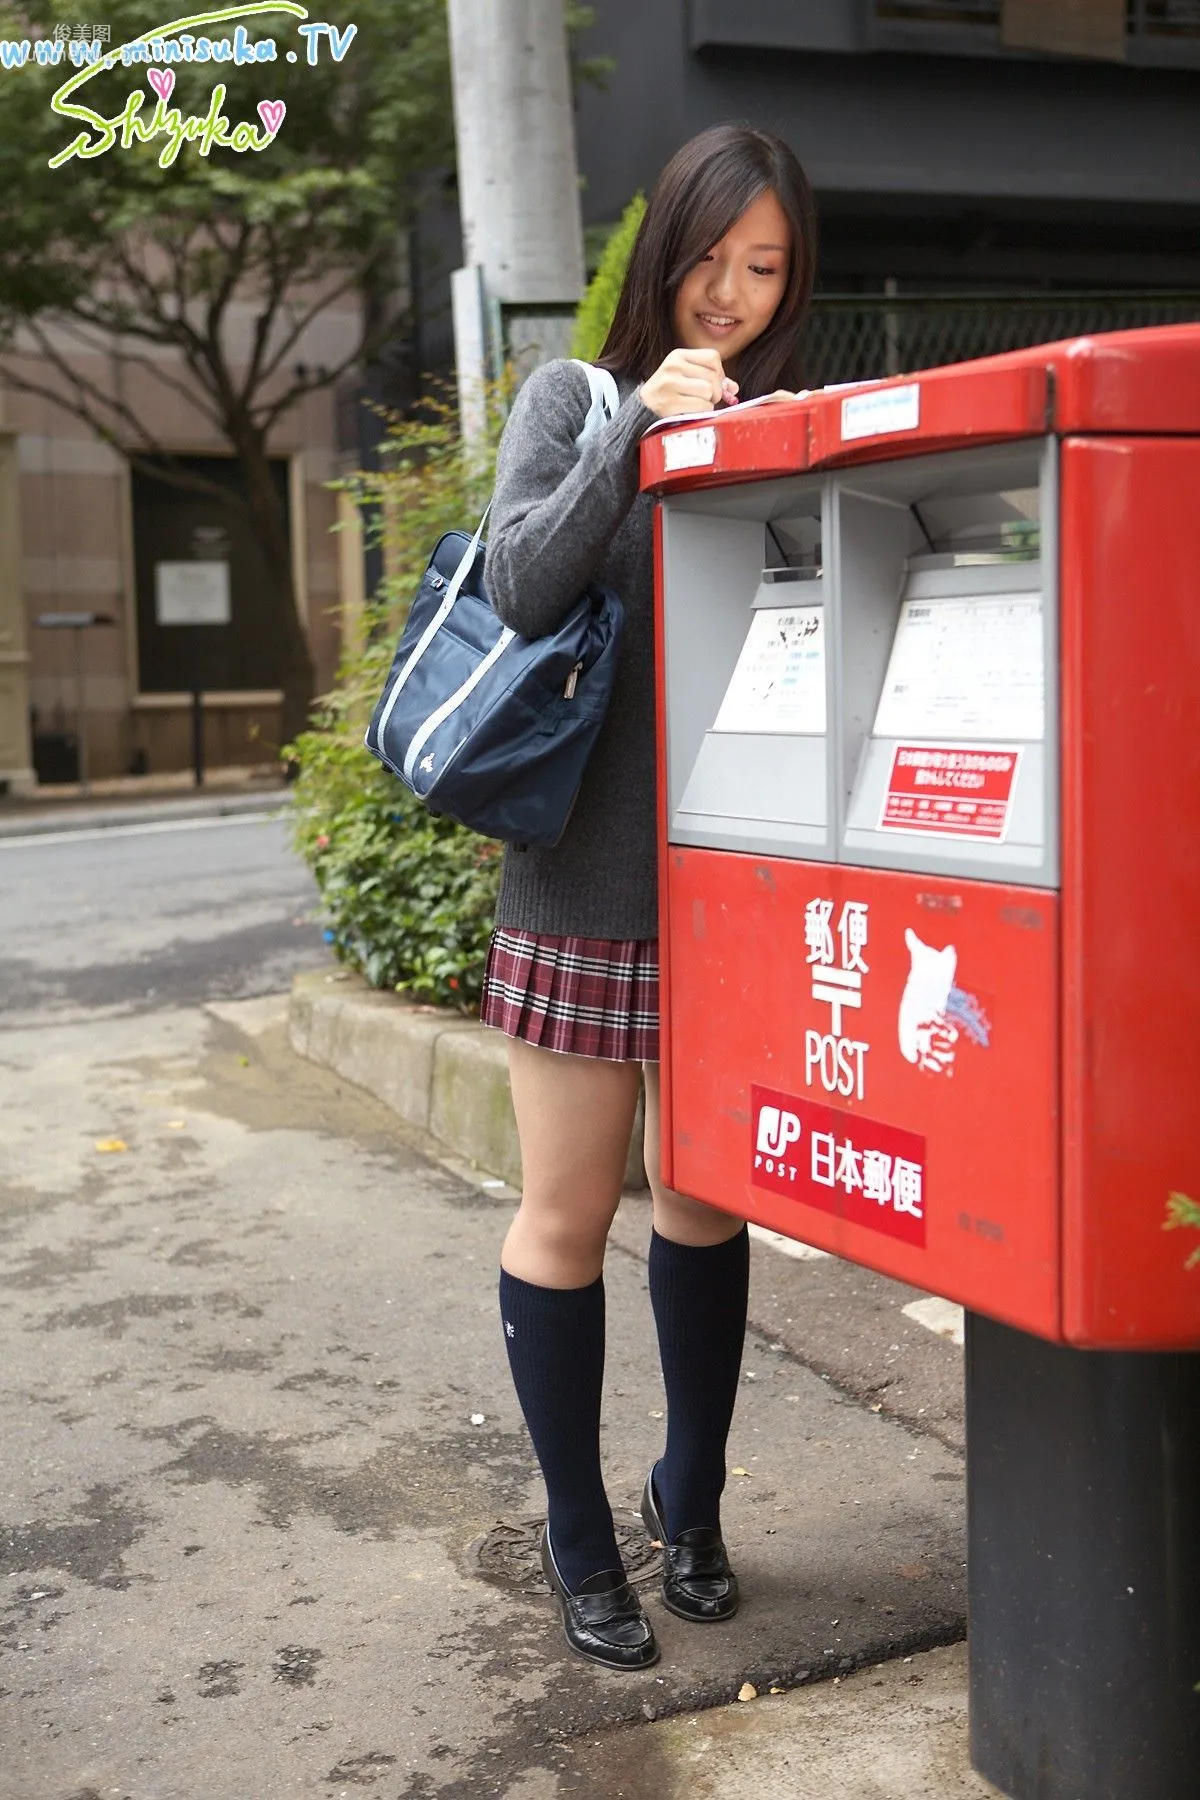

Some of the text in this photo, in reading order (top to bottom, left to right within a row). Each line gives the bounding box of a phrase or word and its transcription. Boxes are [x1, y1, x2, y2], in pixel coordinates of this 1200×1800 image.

[804, 897, 869, 974] 郵便
[805, 1029, 869, 1101] POST
[754, 1154, 798, 1181] POST
[810, 1130, 923, 1219] 日本郵便
